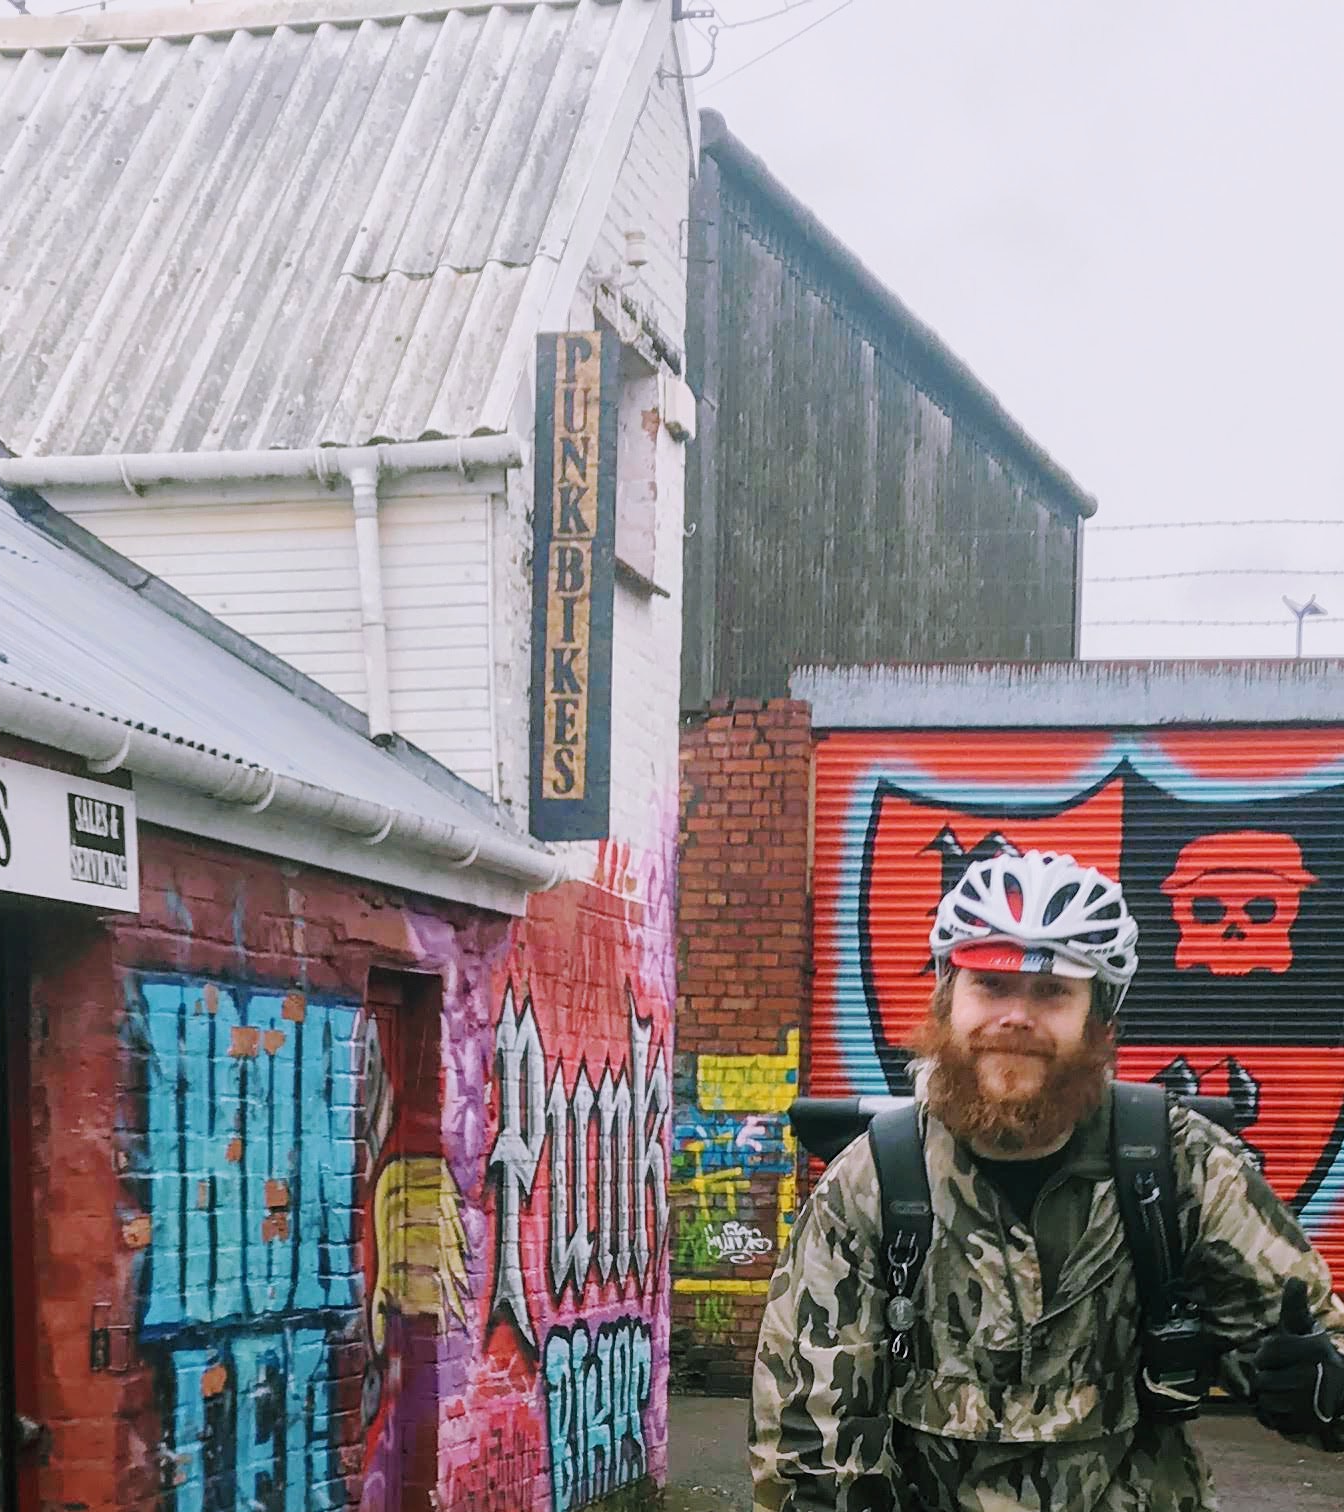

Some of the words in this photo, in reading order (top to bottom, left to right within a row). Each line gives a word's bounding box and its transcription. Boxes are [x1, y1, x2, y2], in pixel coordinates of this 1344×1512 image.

[559, 337, 592, 534] PUNK
[551, 547, 586, 794] BIKES
[70, 844, 128, 889] SERVICING
[74, 796, 109, 837] SALES
[488, 972, 670, 1349] Punk
